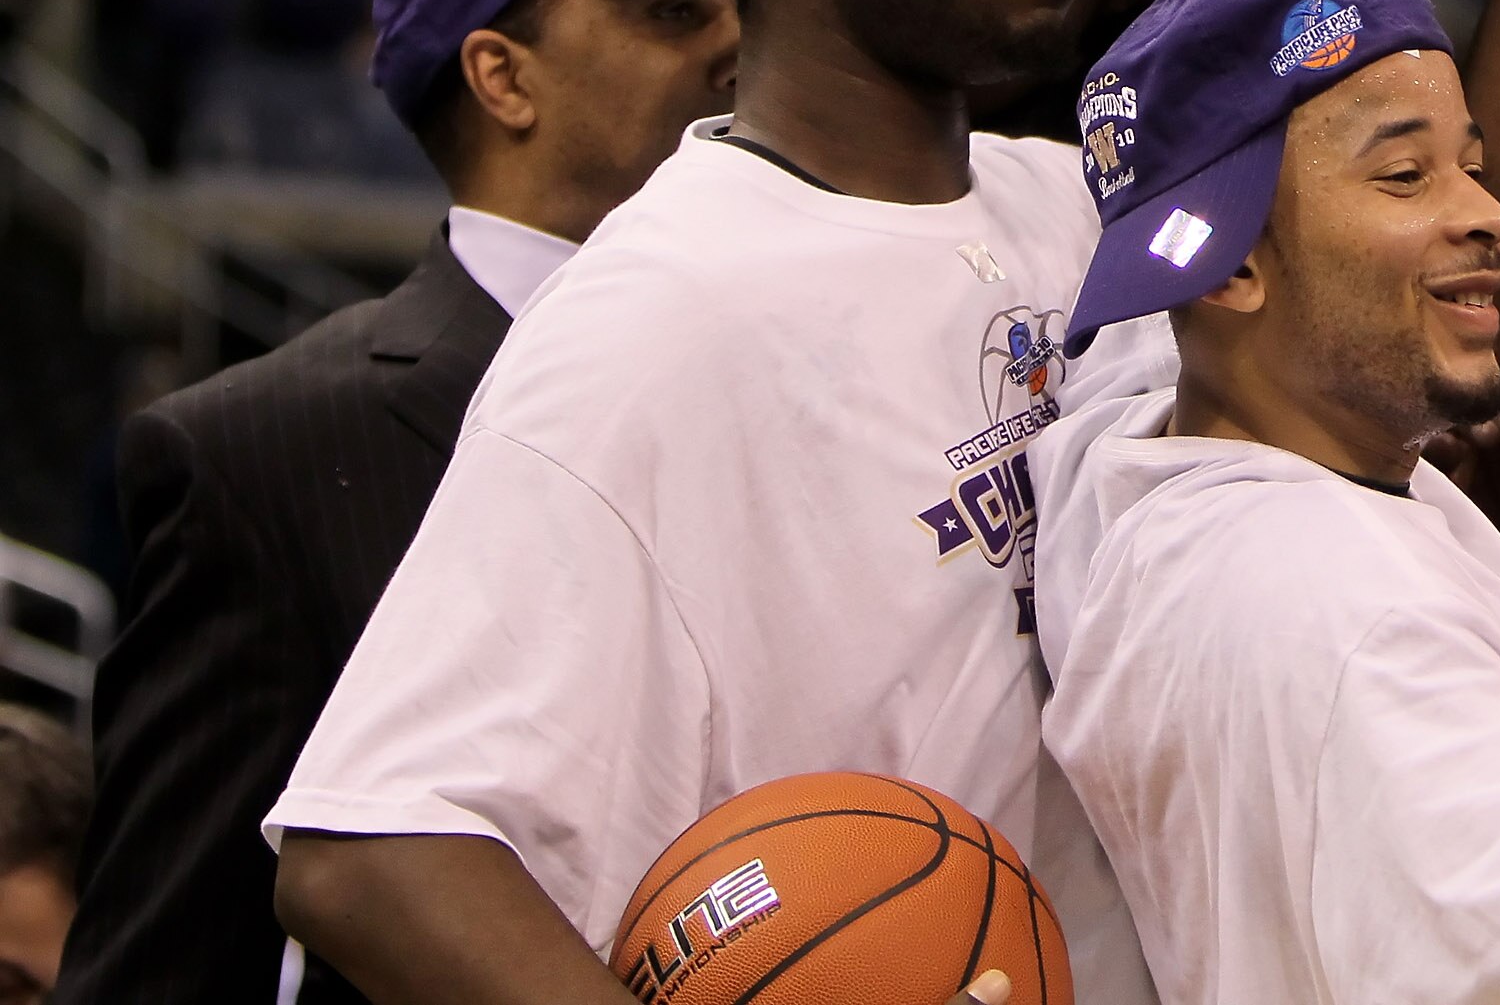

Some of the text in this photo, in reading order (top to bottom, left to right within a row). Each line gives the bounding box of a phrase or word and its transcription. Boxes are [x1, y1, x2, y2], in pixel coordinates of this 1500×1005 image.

[1086, 121, 1121, 176] W
[1115, 127, 1136, 148] 10
[656, 903, 782, 1005] MPIONSHIP
